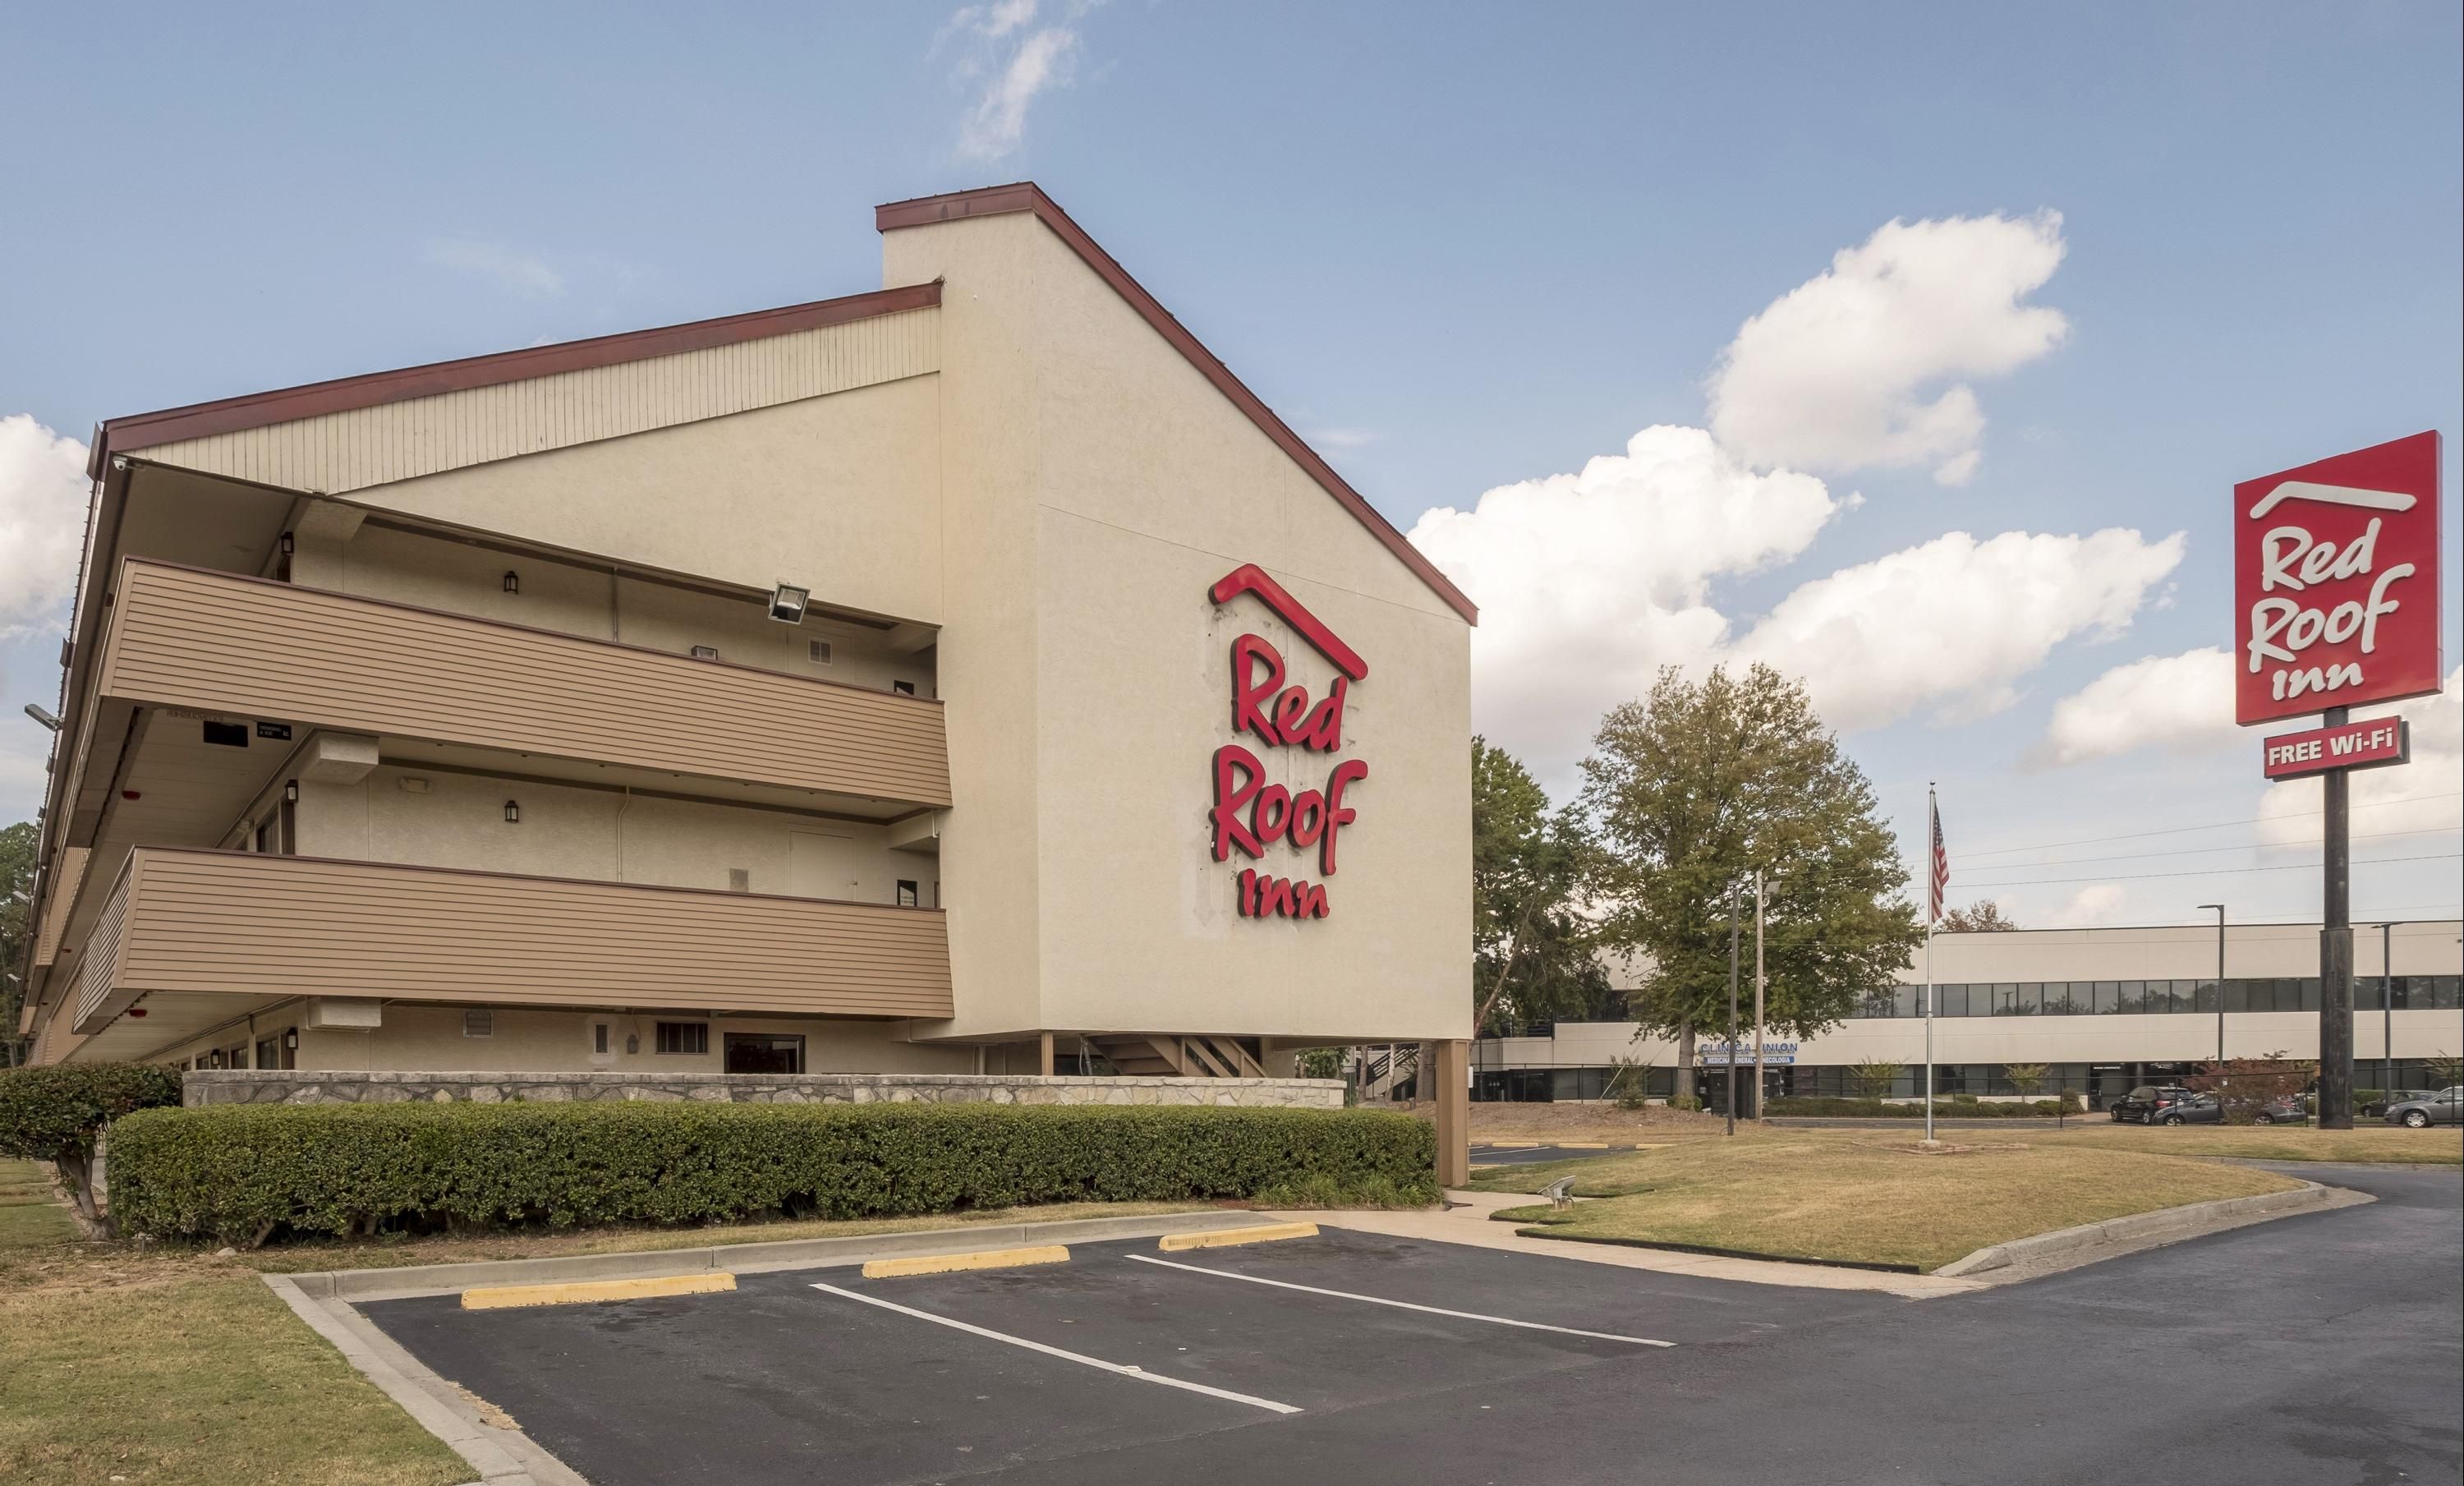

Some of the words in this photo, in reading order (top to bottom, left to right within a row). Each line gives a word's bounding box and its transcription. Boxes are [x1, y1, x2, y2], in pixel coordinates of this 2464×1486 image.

[2262, 518, 2382, 591] Red
[2248, 564, 2416, 673] Roof
[1232, 633, 1347, 752] Red
[2269, 739, 2323, 766] FREE
[2329, 727, 2393, 756] Wi-Fi
[1209, 745, 1368, 876] Roof
[1700, 1043, 1751, 1052] CLINCA
